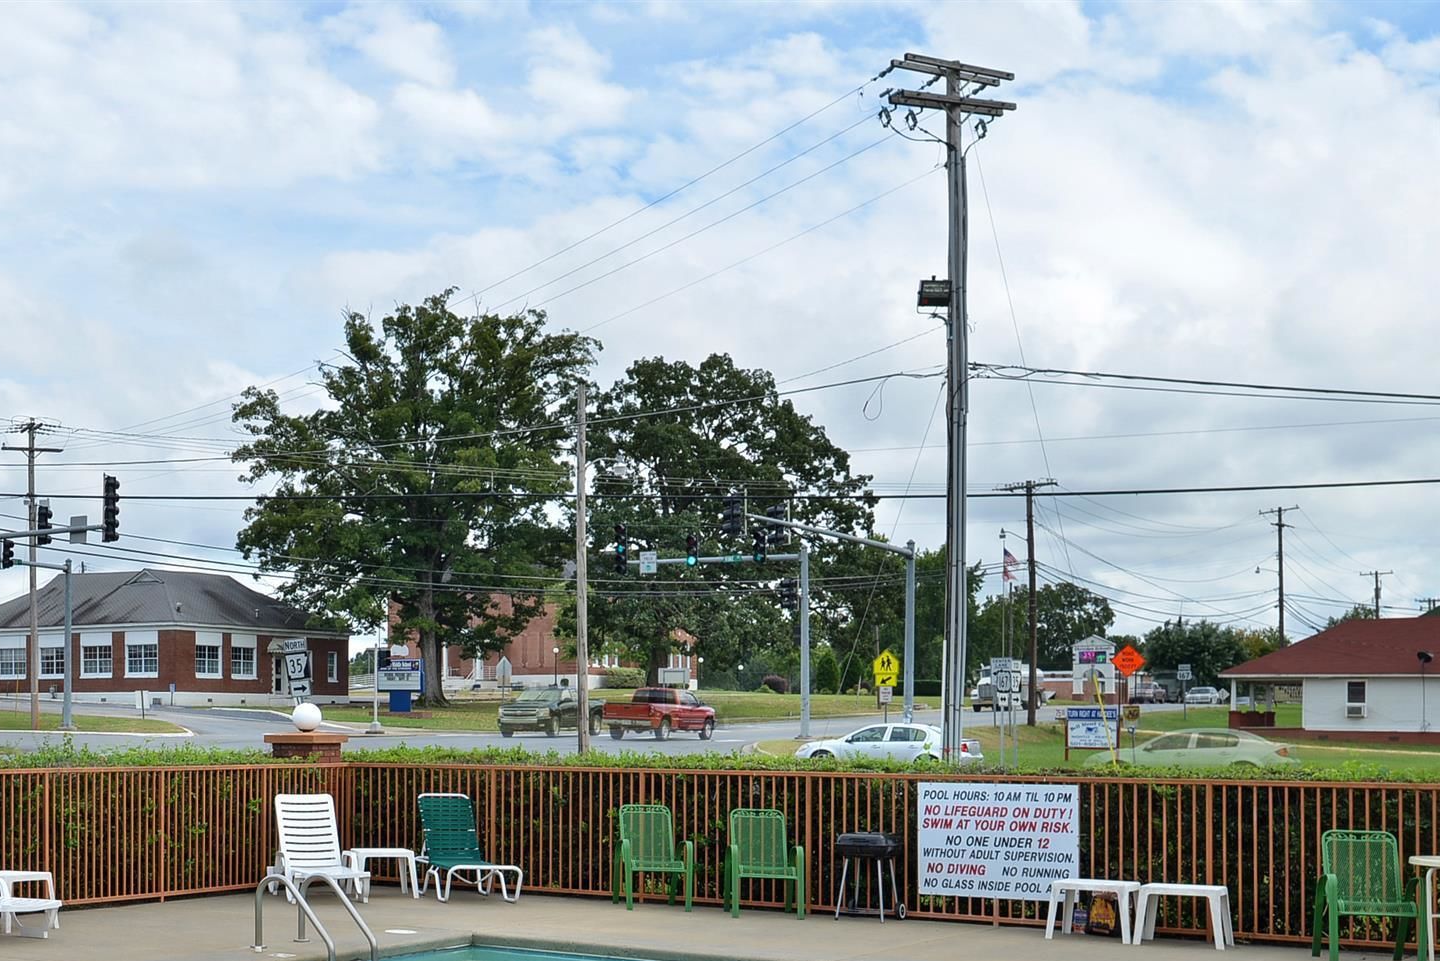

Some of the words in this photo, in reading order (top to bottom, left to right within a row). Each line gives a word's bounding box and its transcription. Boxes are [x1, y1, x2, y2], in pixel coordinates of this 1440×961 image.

[284, 640, 305, 650] NORTH
[289, 658, 303, 674] 35
[923, 790, 949, 800] POOL
[952, 790, 990, 801] HOURS:
[1025, 792, 1040, 802] TIL
[1044, 792, 1055, 803] 10
[1056, 793, 1073, 803] PM
[924, 805, 941, 816] NO
[944, 805, 1008, 818] LIFEGUARD
[1012, 807, 1030, 818] ON
[922, 818, 953, 829] SWIM
[956, 819, 971, 830] AT
[975, 820, 1006, 831] YOUR
[1009, 821, 1037, 833] OWN
[1041, 822, 1074, 834] RISK.
[945, 835, 962, 846] NO
[966, 836, 990, 847] ONE
[993, 837, 1033, 849] UNDER
[1037, 838, 1050, 849] 12
[923, 847, 967, 859] WITHOUT
[969, 849, 1000, 860] ADULT
[1003, 851, 1074, 864] SUPERVISION.
[927, 862, 944, 874] NO
[947, 863, 986, 876] DIVING
[1002, 866, 1018, 877] NO
[1022, 867, 1070, 879] RUNNING
[924, 877, 939, 888] NO
[941, 878, 975, 890] GLASS
[977, 881, 1011, 892] INSIDE
[1015, 882, 1042, 893] POOL
